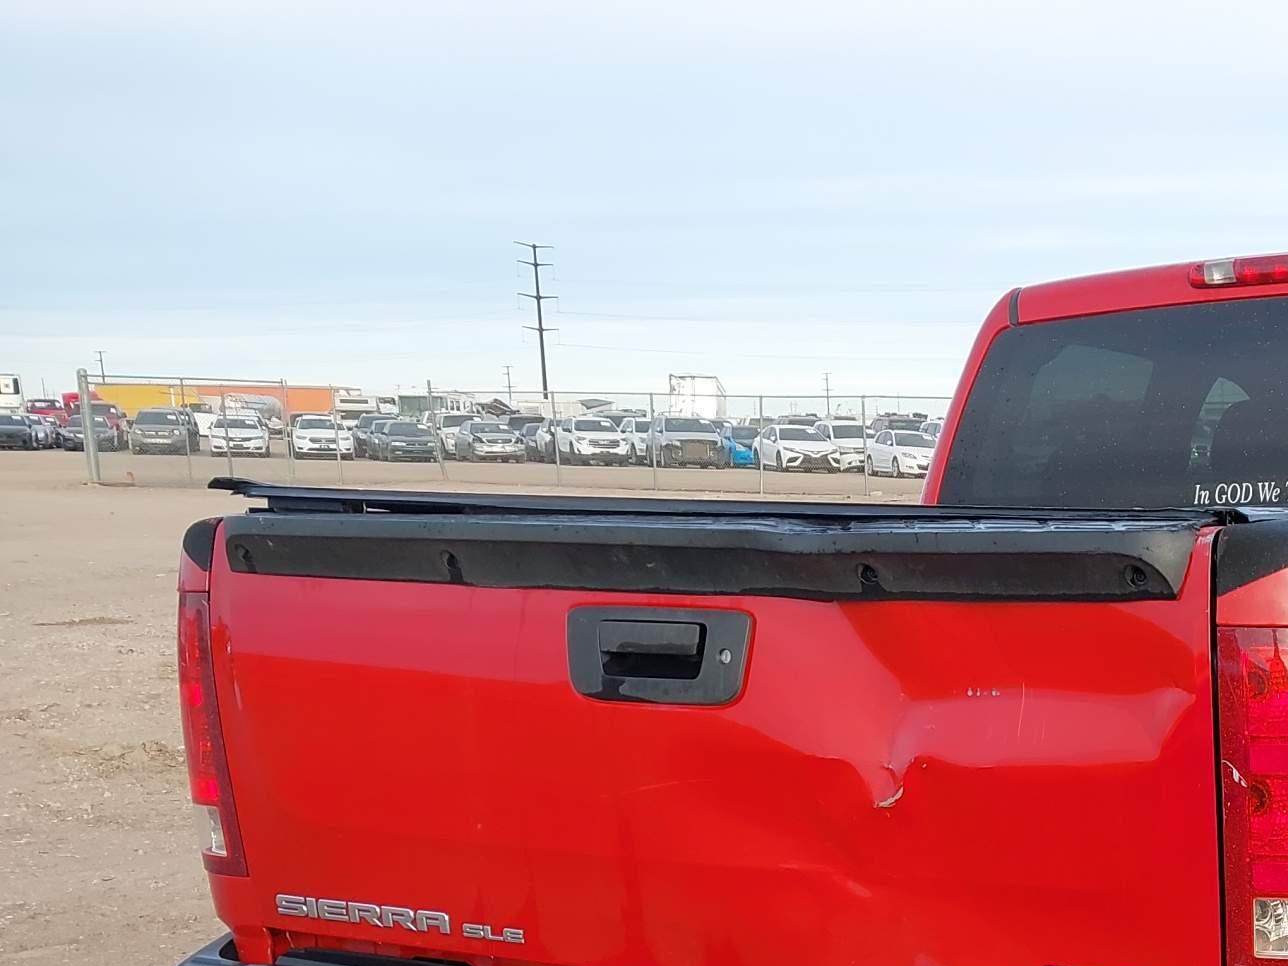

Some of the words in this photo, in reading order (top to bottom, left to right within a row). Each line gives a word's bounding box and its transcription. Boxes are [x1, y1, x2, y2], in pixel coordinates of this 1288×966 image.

[1194, 484, 1210, 505] In
[1215, 482, 1253, 504] GOD
[1257, 481, 1281, 503] We
[275, 893, 451, 935] SIERRA
[462, 922, 526, 944] SLE
